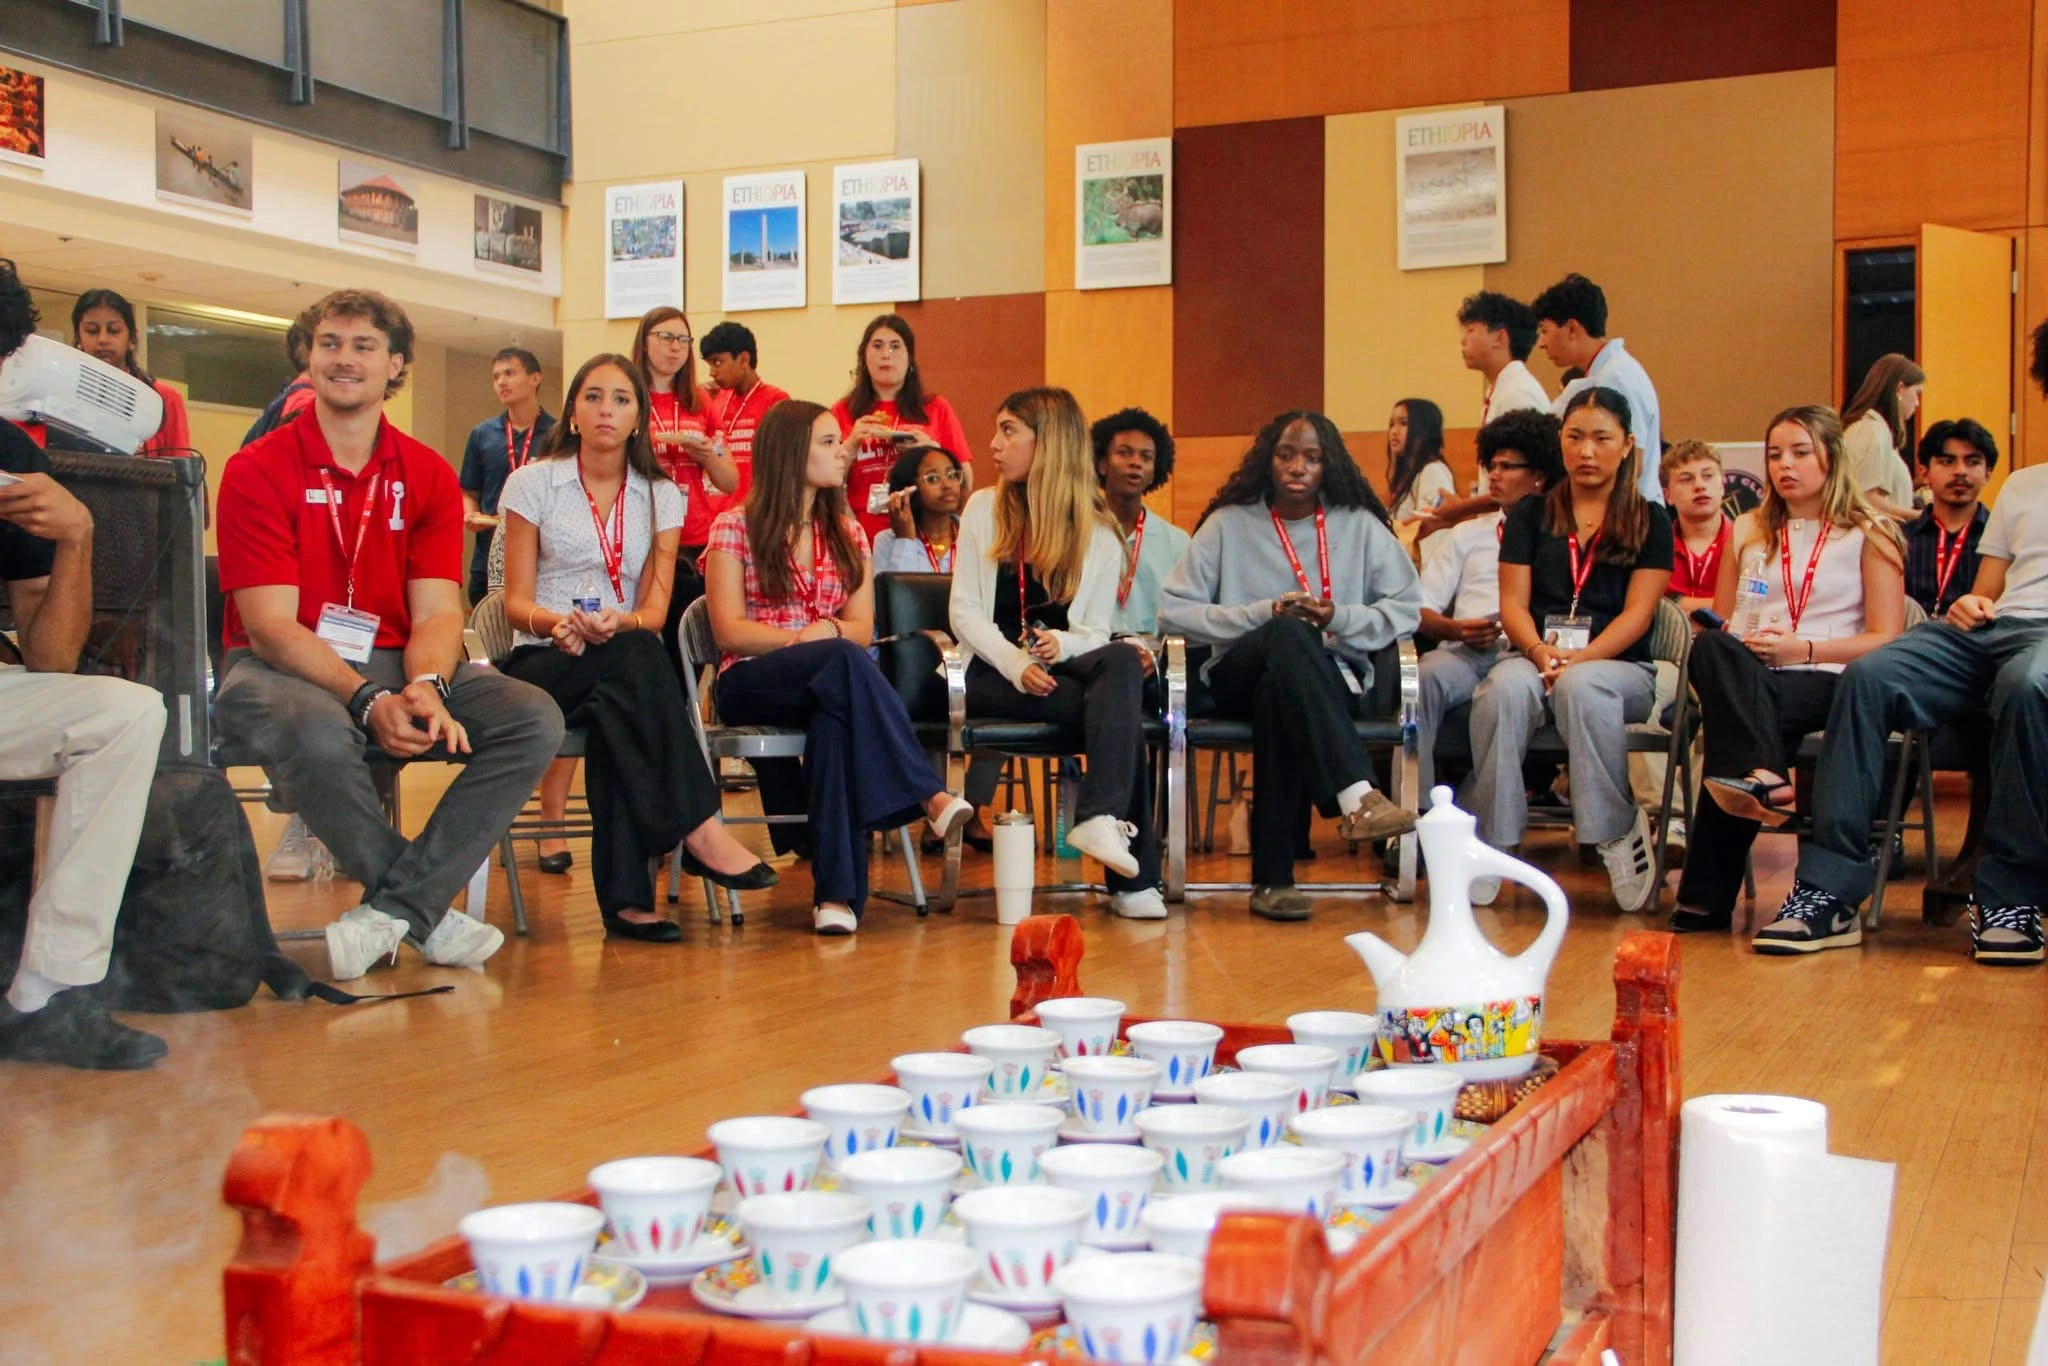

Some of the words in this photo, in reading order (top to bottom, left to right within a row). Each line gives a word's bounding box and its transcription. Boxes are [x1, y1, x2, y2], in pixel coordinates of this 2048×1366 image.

[1408, 121, 1493, 147] ETHIOPIA
[1087, 151, 1162, 173] ETHIOPIA
[733, 184, 798, 204] ETHIOPIA
[842, 175, 908, 197] ETHIOPIA
[615, 192, 676, 214] ETHIOPIA
